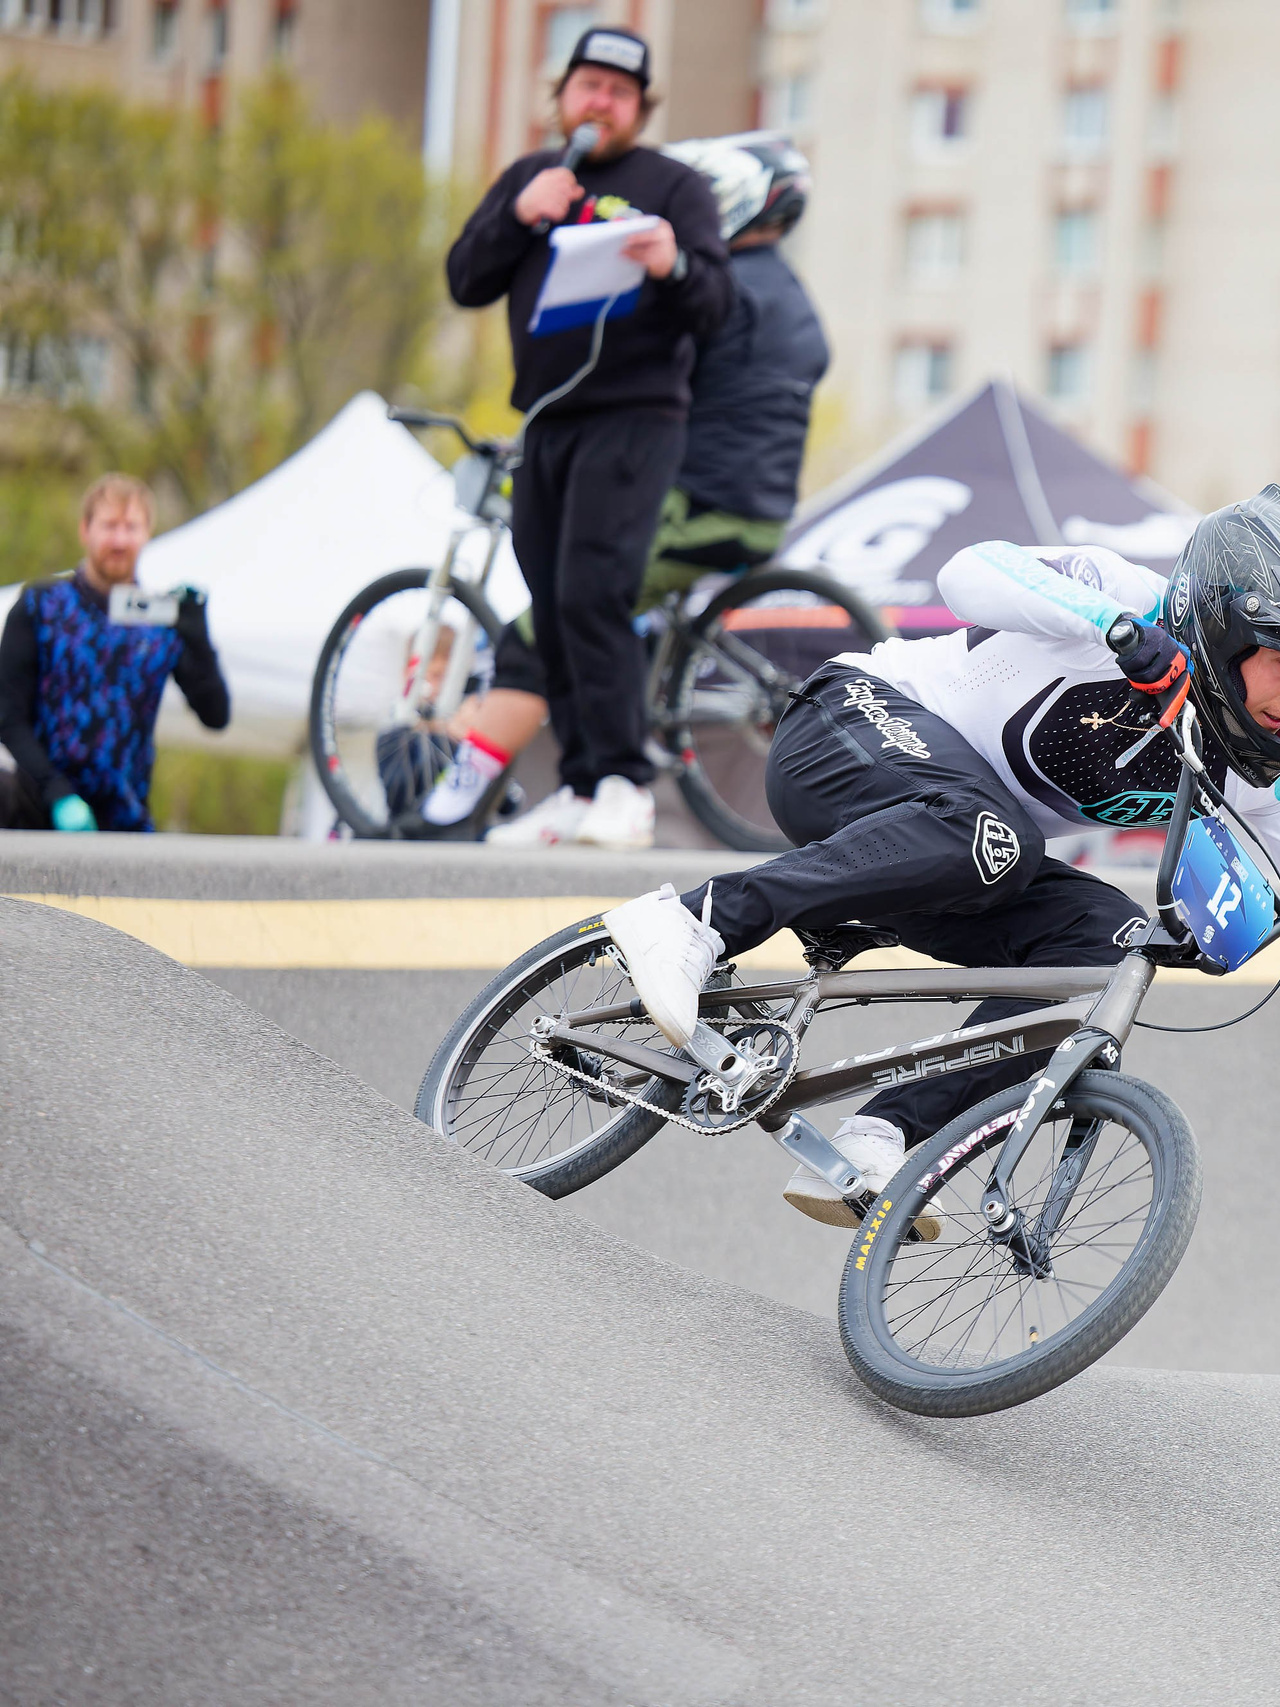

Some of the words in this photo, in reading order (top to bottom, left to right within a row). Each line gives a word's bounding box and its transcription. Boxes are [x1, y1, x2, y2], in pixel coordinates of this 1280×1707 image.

[1206, 871, 1243, 930] 12
[872, 1034, 1025, 1089] INSPYRE
[1101, 1041, 1120, 1064] X5
[854, 1199, 893, 1271] MAXXIS
